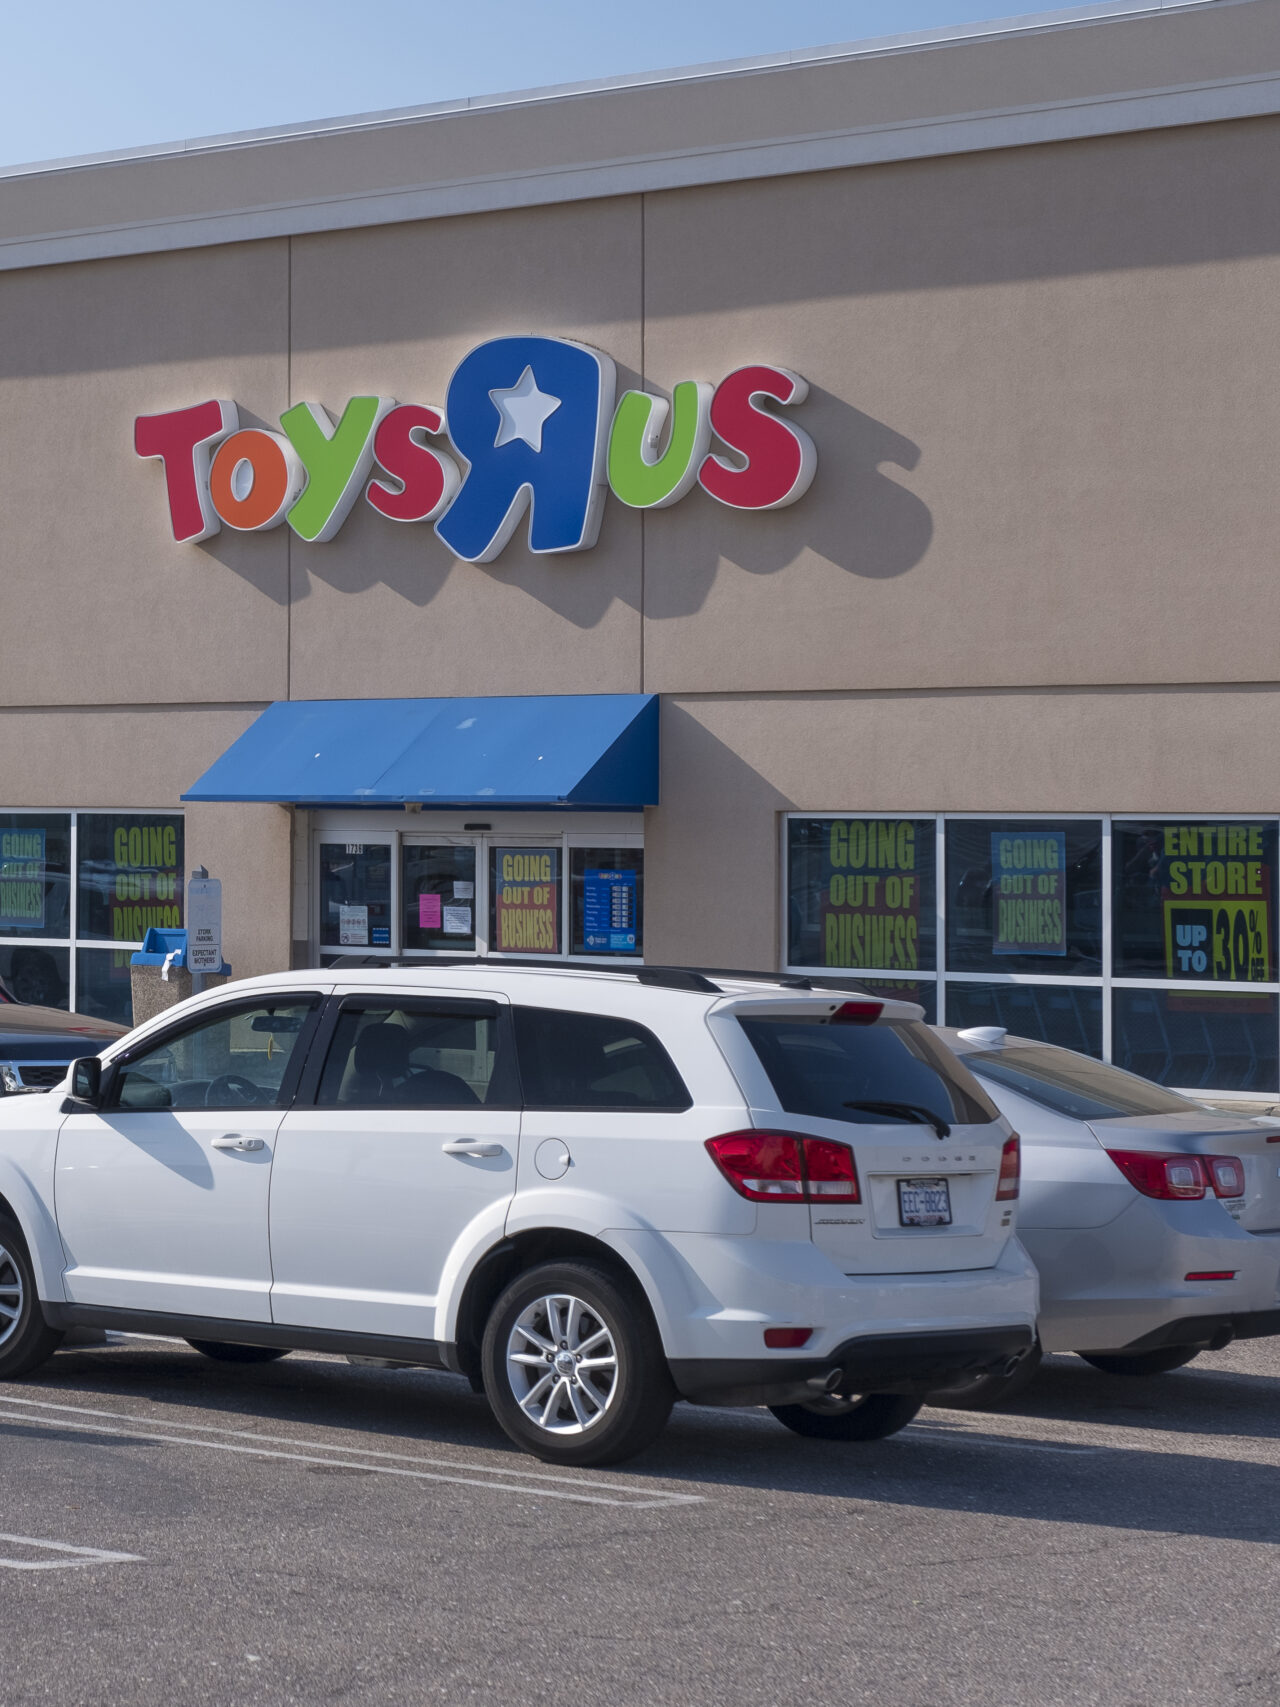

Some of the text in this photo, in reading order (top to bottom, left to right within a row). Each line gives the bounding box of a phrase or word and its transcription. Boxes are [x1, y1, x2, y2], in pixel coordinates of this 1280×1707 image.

[2, 833, 41, 858] GOING
[114, 826, 176, 867] GOING
[830, 820, 915, 870] GOING
[1000, 839, 1059, 869] GOING
[1164, 826, 1263, 856] ENTIRE
[2, 862, 40, 878] OUT OF
[503, 854, 550, 882] GOING
[1170, 861, 1263, 895] STORE
[116, 873, 176, 901] OUT OF
[503, 887, 550, 904] OUT OF
[830, 874, 915, 908] OUT OF
[1001, 875, 1058, 894] OUT OF
[0, 882, 41, 918] BUSINESS
[501, 909, 553, 949] BUSINESS
[999, 899, 1062, 944] BUSINESS
[1176, 925, 1207, 946] UP
[826, 912, 918, 988] BUSINESS
[1177, 950, 1207, 972] TO
